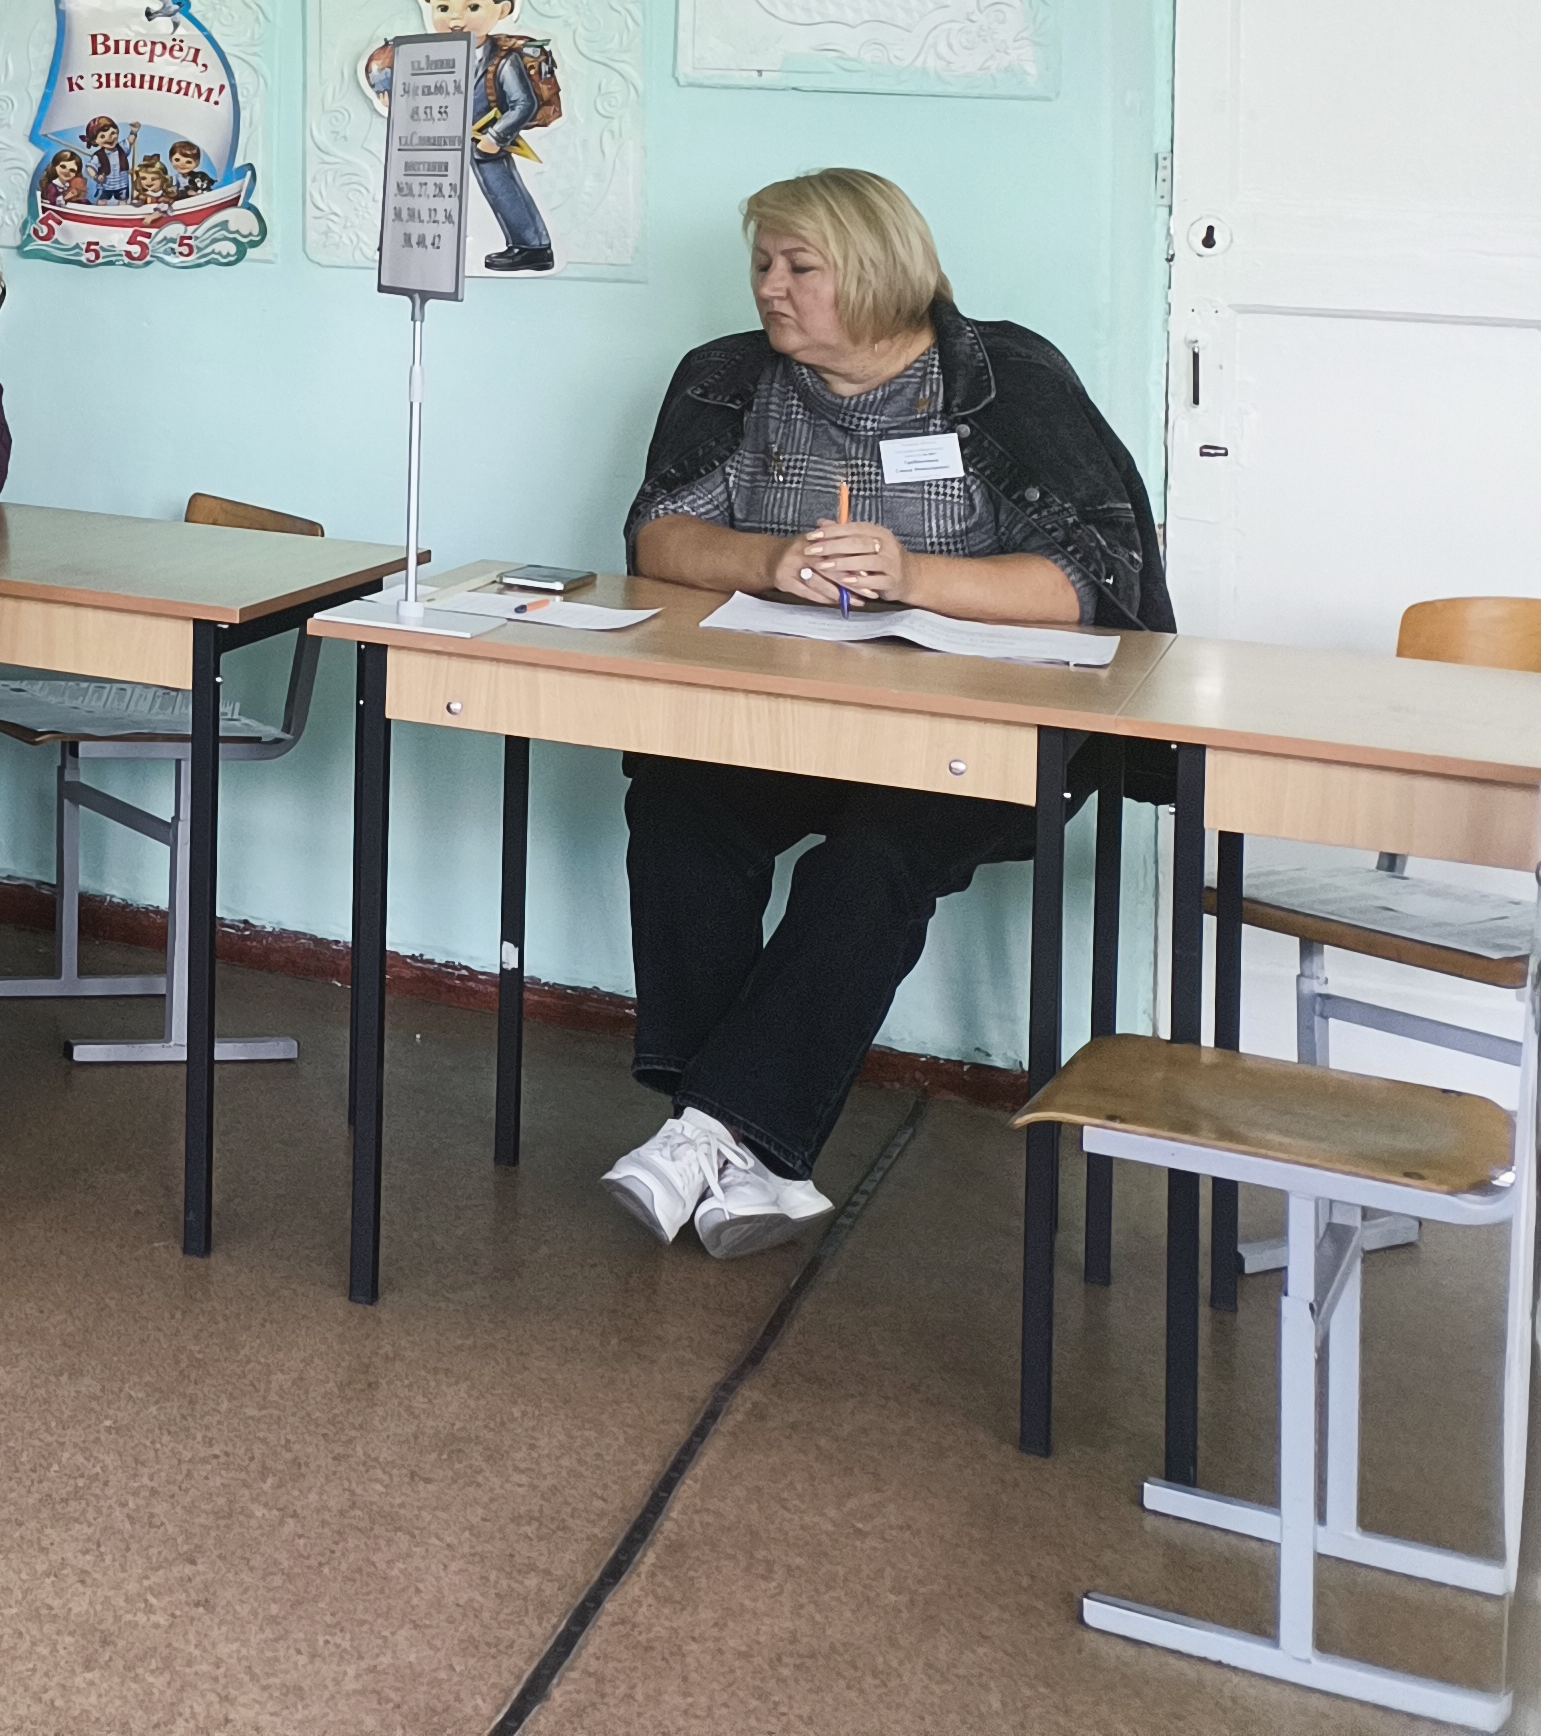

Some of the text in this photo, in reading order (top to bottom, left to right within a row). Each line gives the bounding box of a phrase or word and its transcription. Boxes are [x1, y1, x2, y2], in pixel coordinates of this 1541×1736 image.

[88, 32, 209, 74] Вперёд,
[67, 72, 226, 106] к знаниям!
[32, 212, 63, 242] 5
[84, 241, 101, 263] 5
[123, 229, 153, 262] 5
[177, 235, 195, 258] 5
